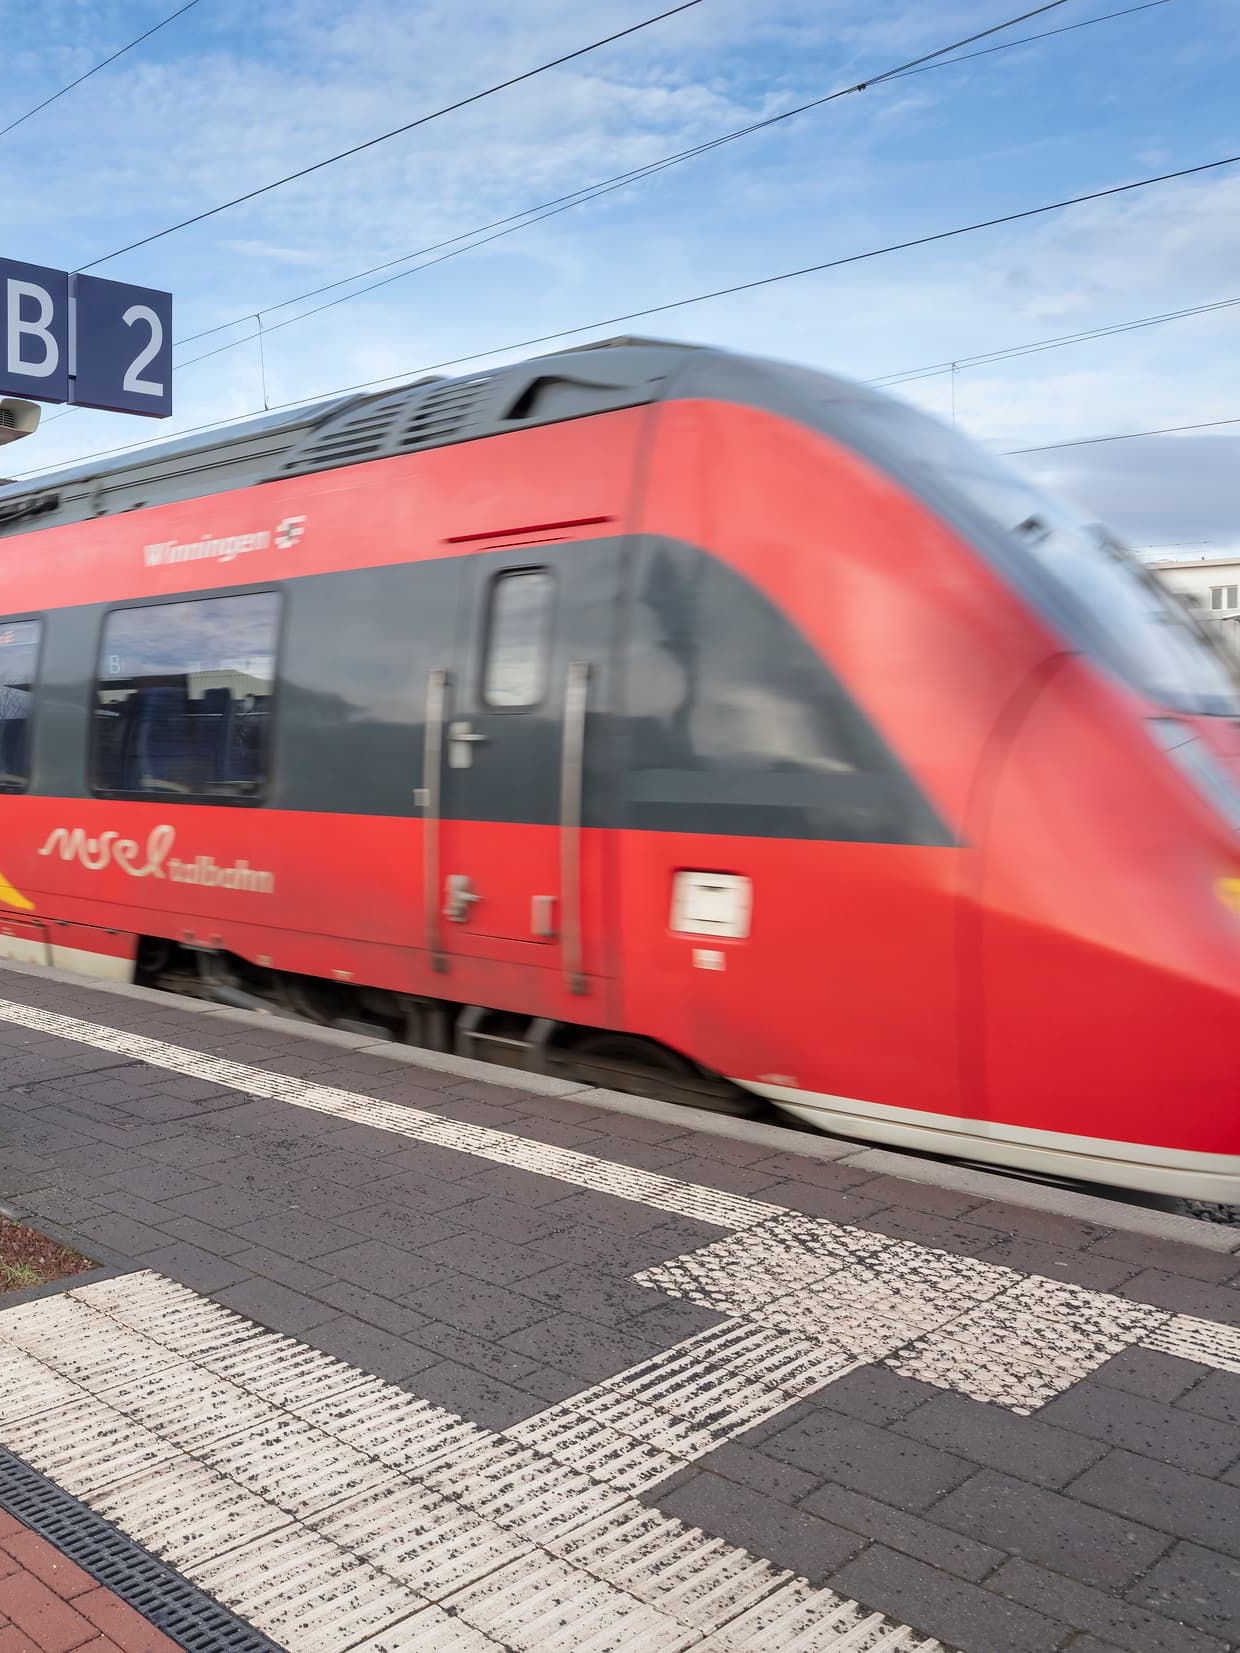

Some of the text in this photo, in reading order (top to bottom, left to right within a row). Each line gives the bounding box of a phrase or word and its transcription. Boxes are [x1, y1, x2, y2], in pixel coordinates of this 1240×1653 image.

[7, 278, 59, 378] B
[122, 304, 164, 397] 2
[144, 530, 271, 567] Winningen
